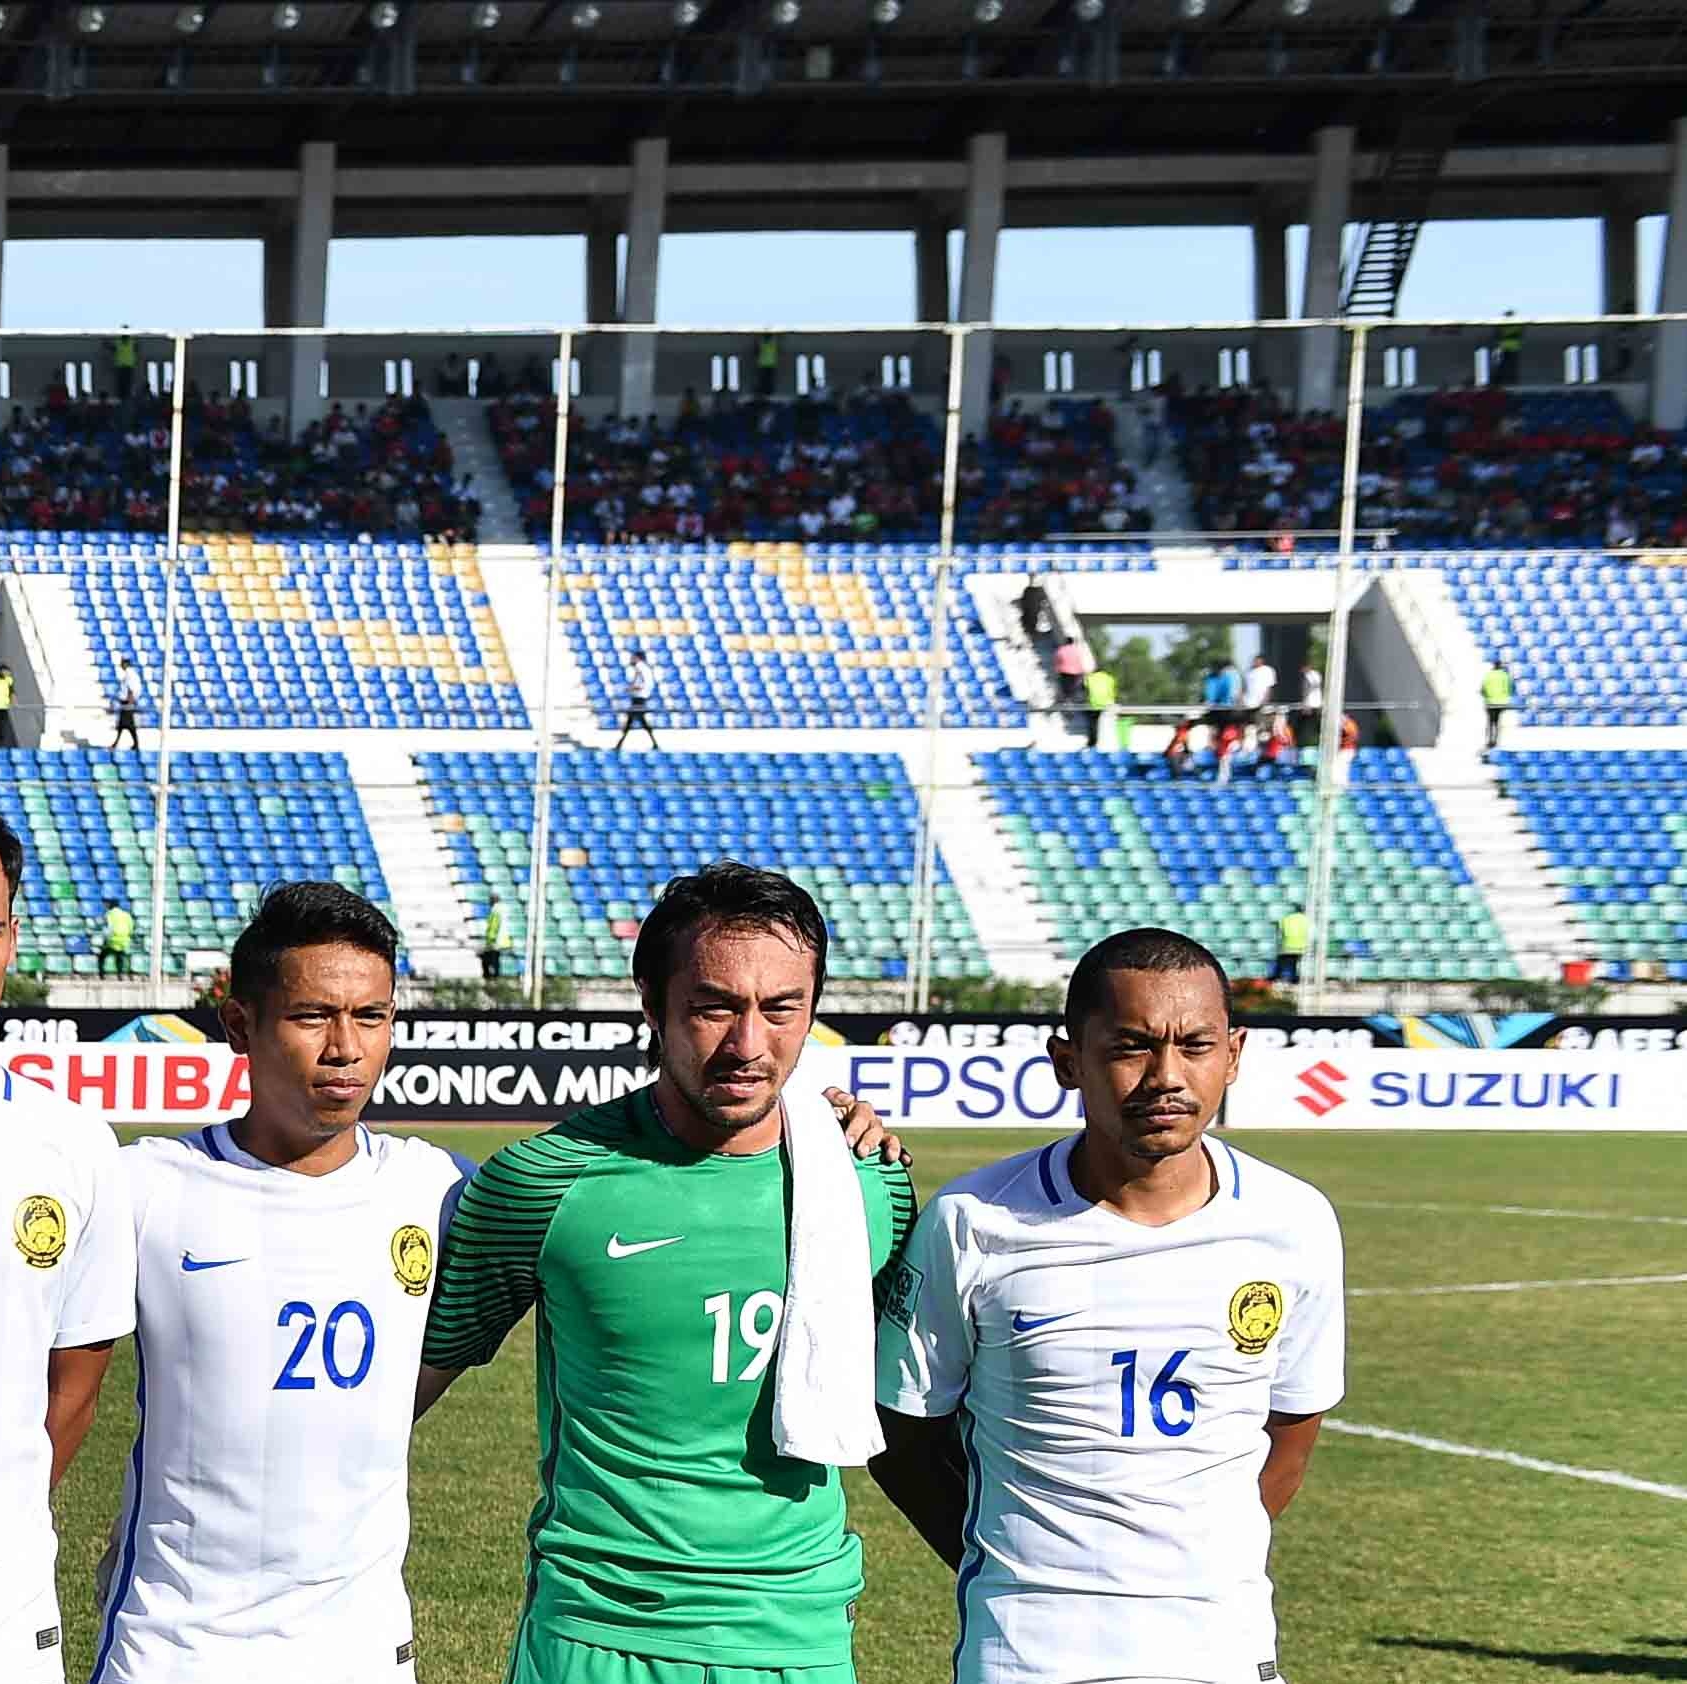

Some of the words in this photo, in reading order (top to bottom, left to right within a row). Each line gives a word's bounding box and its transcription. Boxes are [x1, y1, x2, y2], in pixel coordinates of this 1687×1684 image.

[3, 1018, 78, 1043] 2016
[390, 1021, 535, 1050] UZUKI
[537, 1021, 635, 1050] CUP
[372, 1064, 547, 1106] KONICA
[849, 1055, 1084, 1120] EPSO
[1371, 1071, 1620, 1109] SUZUKI
[273, 1299, 376, 1391] 20
[702, 1290, 783, 1384] 19
[1111, 1349, 1197, 1438] 16
